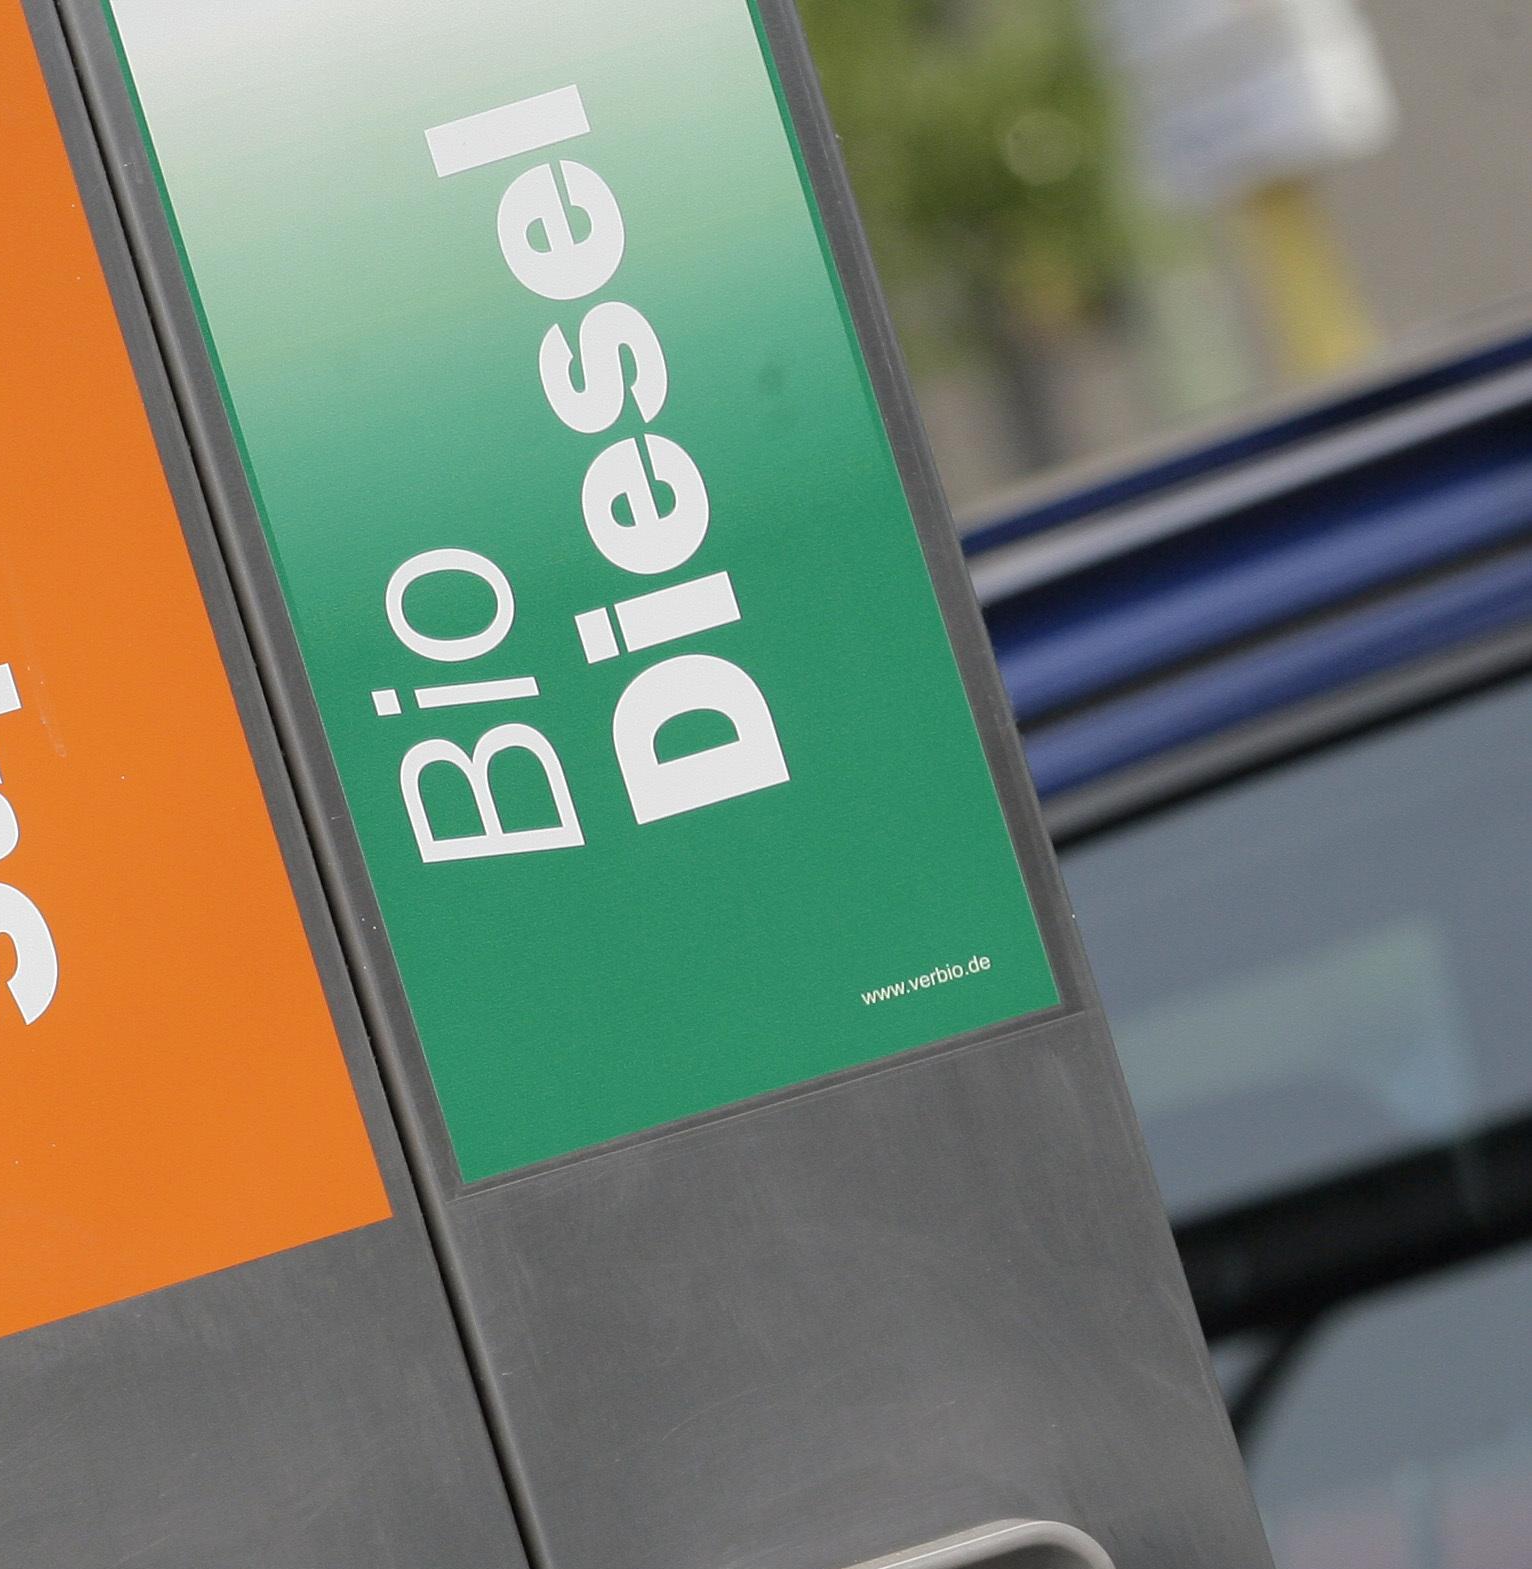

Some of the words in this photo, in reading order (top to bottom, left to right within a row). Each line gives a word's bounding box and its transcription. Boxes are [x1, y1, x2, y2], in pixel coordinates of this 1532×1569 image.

[425, 84, 790, 825] Diesel
[372, 548, 585, 864] Bio
[861, 955, 992, 1006] www.verbio.de
